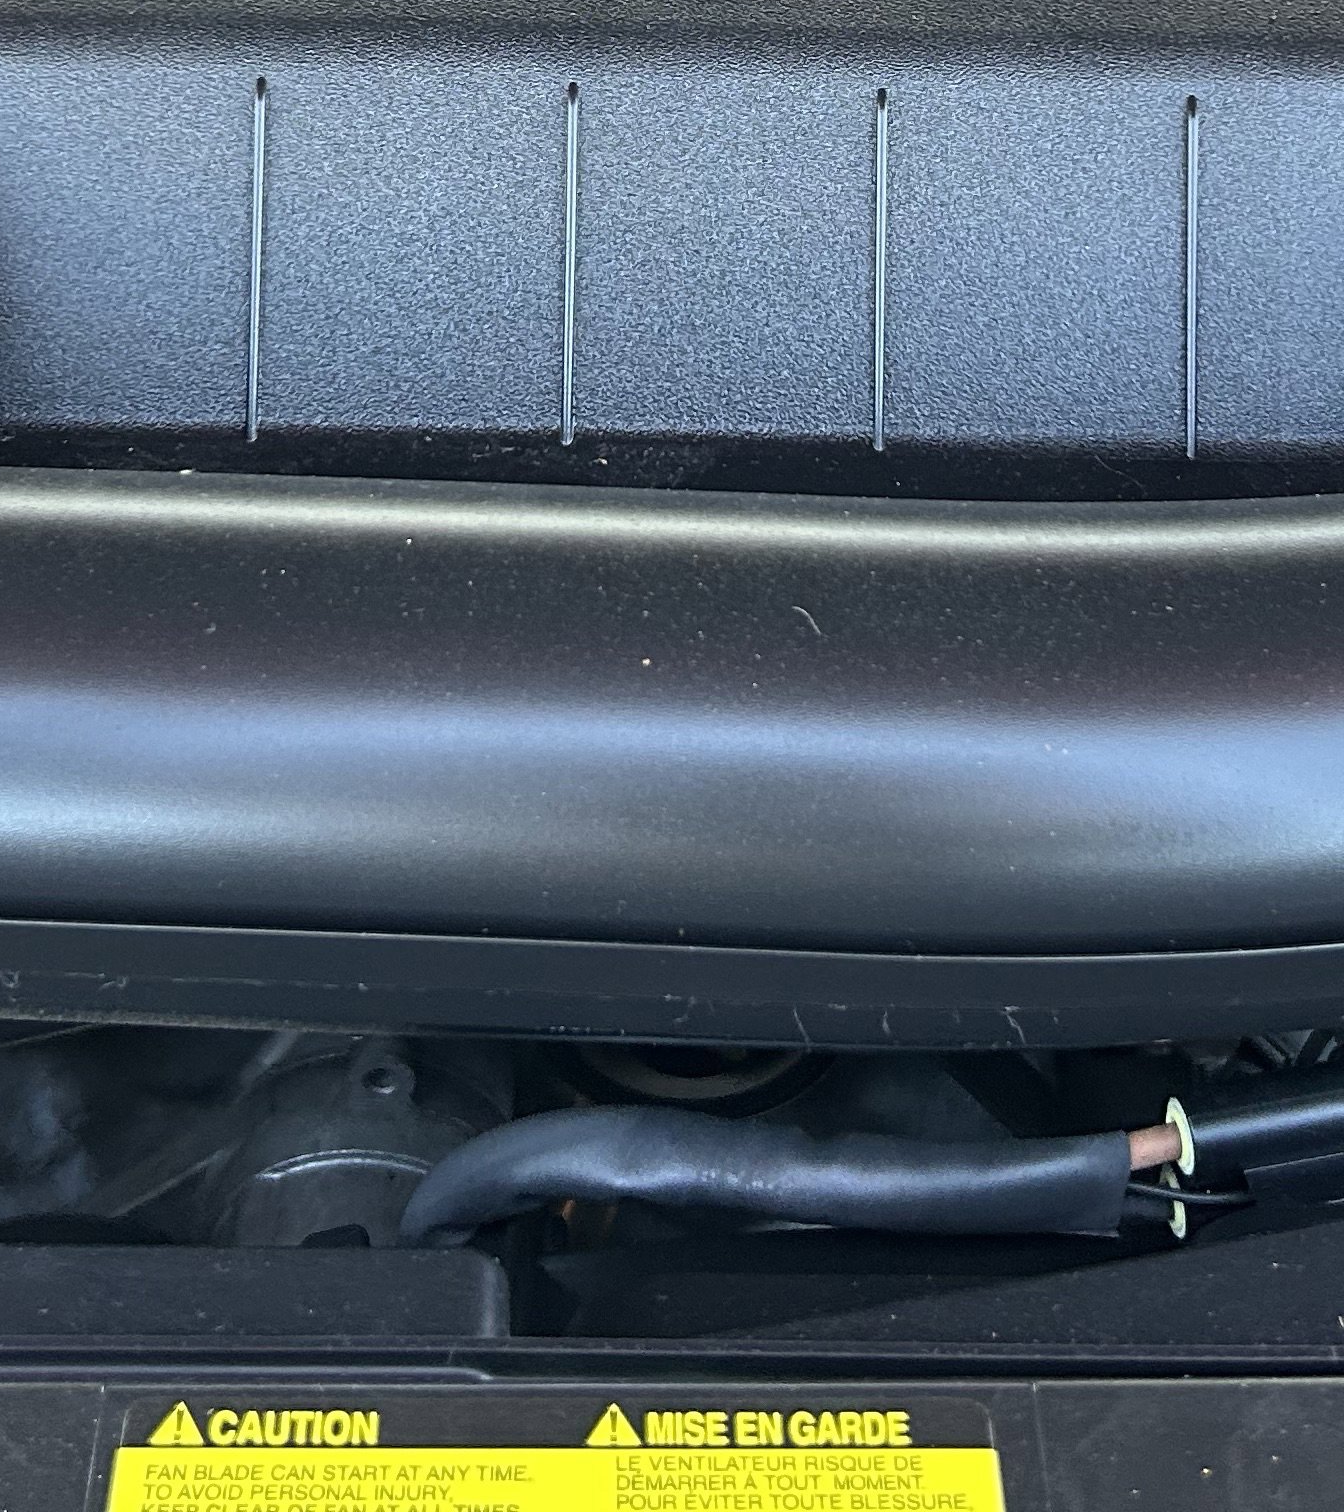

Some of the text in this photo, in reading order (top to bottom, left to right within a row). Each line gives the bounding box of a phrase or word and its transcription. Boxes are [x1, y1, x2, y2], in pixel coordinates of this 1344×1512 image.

[209, 1408, 380, 1446] CAUTION
[644, 1409, 913, 1447] MISE EN GARDE
[145, 1464, 535, 1482] FAN BLADE CAN START AT ANY TIME.
[615, 1455, 924, 1472] LE VENTILATEUR RISQUE DE
[615, 1470, 737, 1491] DÉMARRER
[764, 1474, 822, 1491] TOUT
[143, 1483, 173, 1501] TO
[176, 1483, 244, 1501] AVOID
[249, 1483, 368, 1501] PERSONAL
[616, 1493, 678, 1510] POUR
[684, 1488, 763, 1510] ÉVITER
[769, 1493, 842, 1510] TOUTE
